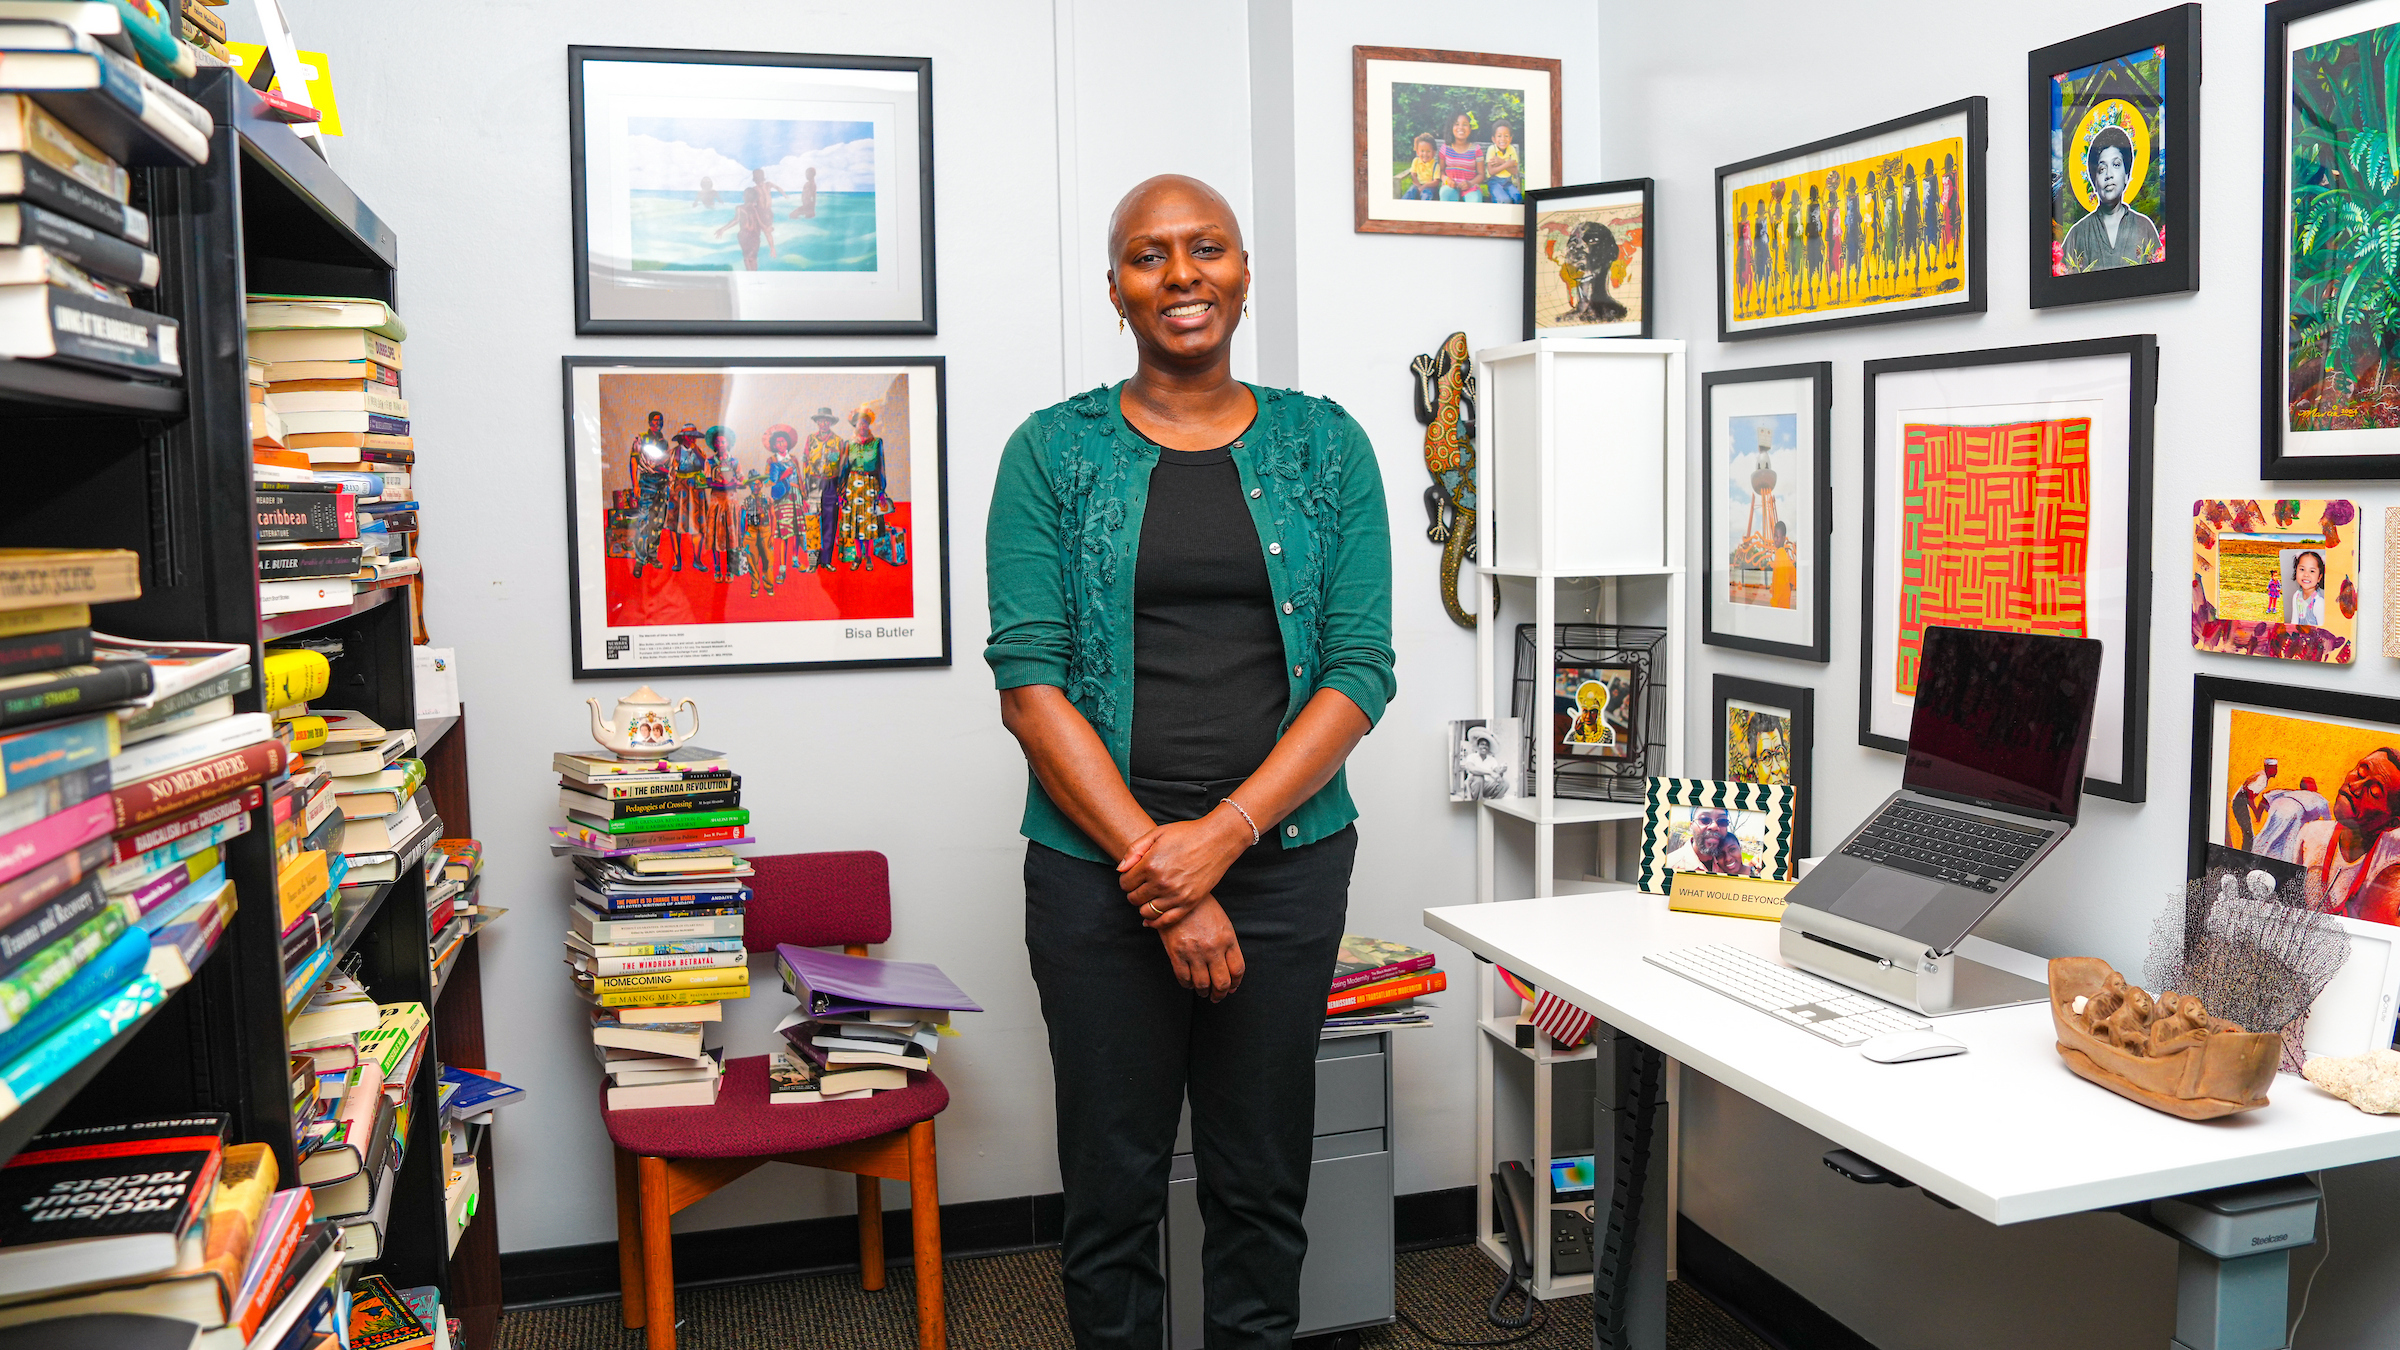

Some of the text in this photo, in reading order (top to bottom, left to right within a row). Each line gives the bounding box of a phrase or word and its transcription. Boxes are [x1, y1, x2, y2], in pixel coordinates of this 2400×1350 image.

[257, 509, 308, 525] caribbean
[260, 530, 289, 538] LITERATURE
[272, 559, 299, 569] BUTLER
[845, 626, 915, 639] Bisa Butler
[147, 754, 248, 801] NO MERCY HERE
[635, 780, 728, 796] THE GRENADA REVOLUTION
[626, 802, 658, 813] Pedagogies
[667, 800, 692, 810] Crossing
[134, 822, 181, 853] RADICALISM
[189, 820, 200, 830] THE
[199, 798, 242, 826] CROSSROADS
[1679, 888, 1705, 898] WHAT
[1706, 891, 1740, 901] WOULD
[0, 890, 94, 960] Trauma and Recovery
[640, 960, 676, 968] WINDRUSH
[680, 957, 714, 966] BETRAYAL
[603, 975, 672, 987] HOMECOMING
[1331, 975, 1370, 990] Posing Modernity
[1357, 995, 1365, 1003] AND
[1366, 988, 1397, 1001] TRANSATLANTIC
[1398, 983, 1422, 995] MODERNISM
[384, 1033, 406, 1070] INVISIBLE MAN
[131, 1118, 218, 1130] EDUARDO
[50, 1170, 192, 1193] racists
[20, 1183, 186, 1212] without
[32, 1197, 179, 1223] racism
[2251, 1233, 2288, 1246] Steelcase
[369, 1331, 424, 1348] JAMAICA
